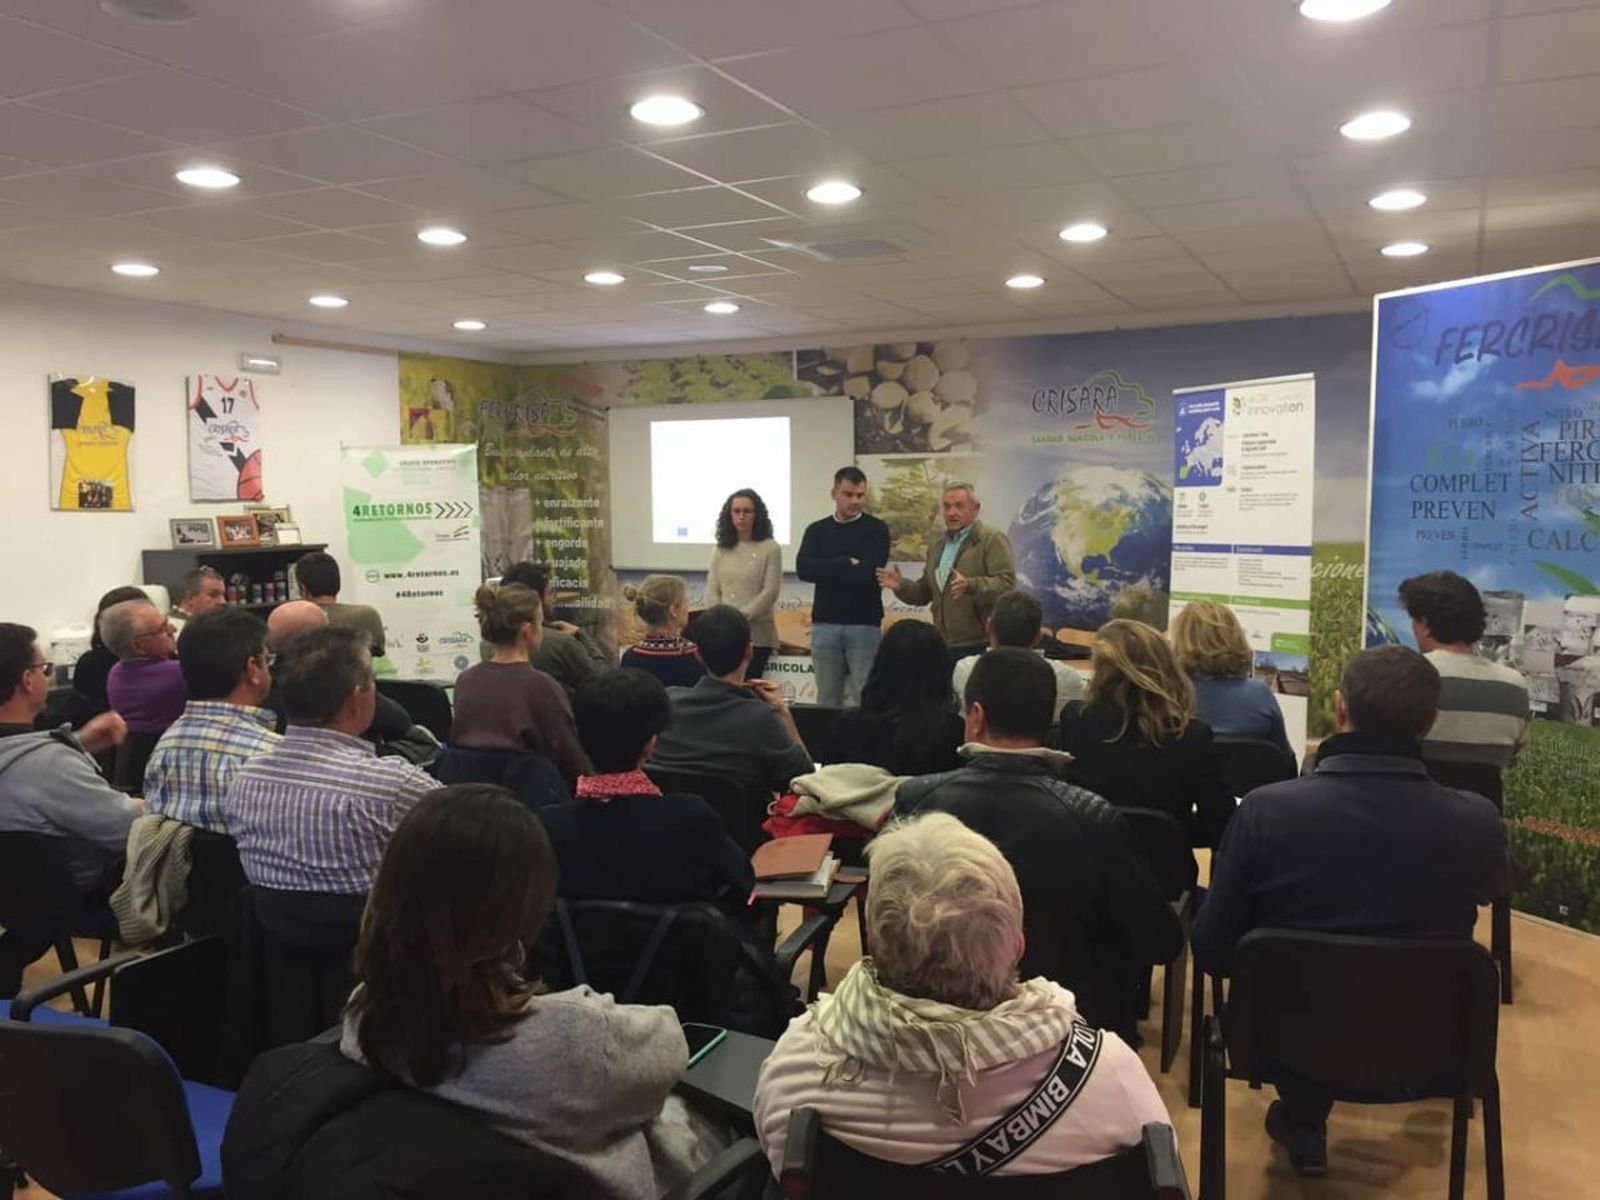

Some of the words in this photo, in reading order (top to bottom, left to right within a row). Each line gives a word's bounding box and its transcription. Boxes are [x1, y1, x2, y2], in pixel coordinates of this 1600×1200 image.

[221, 397, 235, 415] 17
[1032, 386, 1118, 414] CRISARA
[1409, 472, 1512, 493] COMPLET
[352, 501, 432, 518] 4RETORNOS
[1411, 500, 1496, 519] PREVEN
[384, 569, 459, 579] www.4retornos.es
[396, 590, 443, 599] #4Retornos
